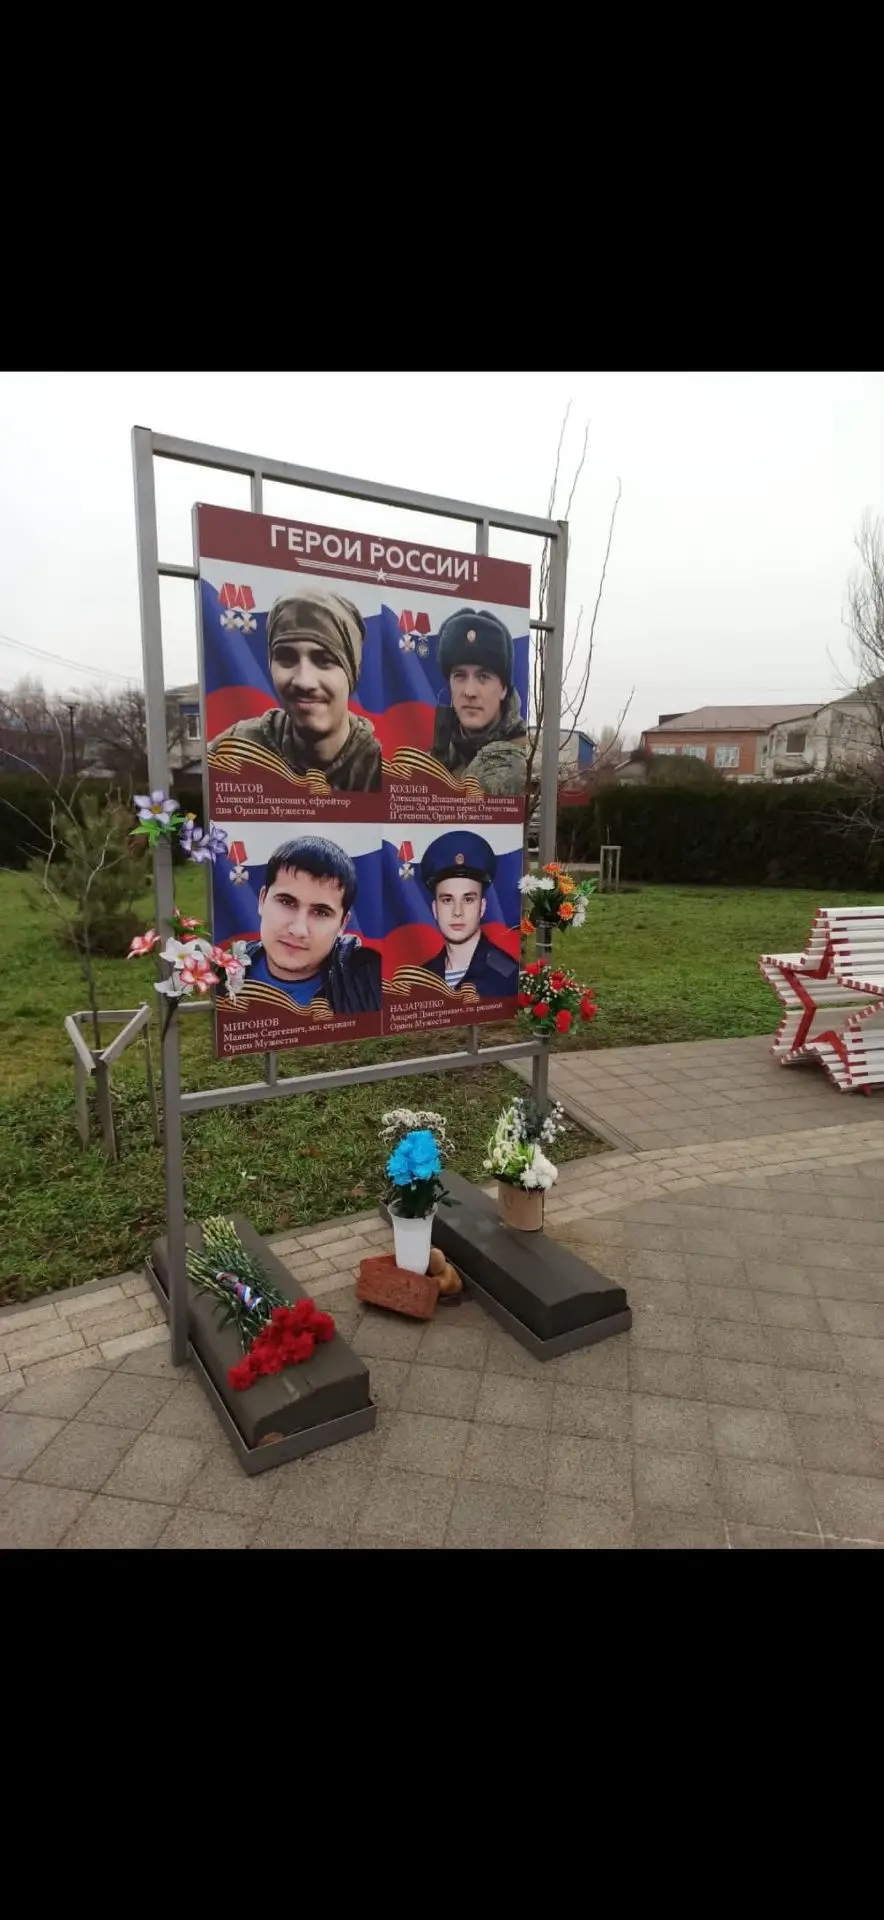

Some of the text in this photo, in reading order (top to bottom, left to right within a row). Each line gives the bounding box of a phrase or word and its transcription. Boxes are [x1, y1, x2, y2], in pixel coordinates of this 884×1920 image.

[271, 524, 479, 582] ГЕРОИ РОССИИ!
[216, 783, 264, 793] ИПАТОВ
[390, 784, 428, 793] КОЗЛОВ
[216, 794, 254, 804] Алексей
[309, 797, 351, 809] ефрейтор
[390, 795, 429, 805] Александр
[234, 805, 269, 816] Ордена
[270, 807, 316, 817] Мужества
[390, 803, 414, 812] Орден
[428, 805, 455, 813] заслуги
[432, 814, 456, 822] Орден
[390, 1000, 444, 1013] НАЗАРЕНКО
[390, 1012, 417, 1022] Андрей
[224, 1018, 279, 1032] МИРОНОВ
[390, 1018, 451, 1031] Орден Мужества
[224, 1030, 259, 1042] Максим
[323, 1020, 356, 1031] сержант
[224, 1037, 299, 1053] Орден Мужества
